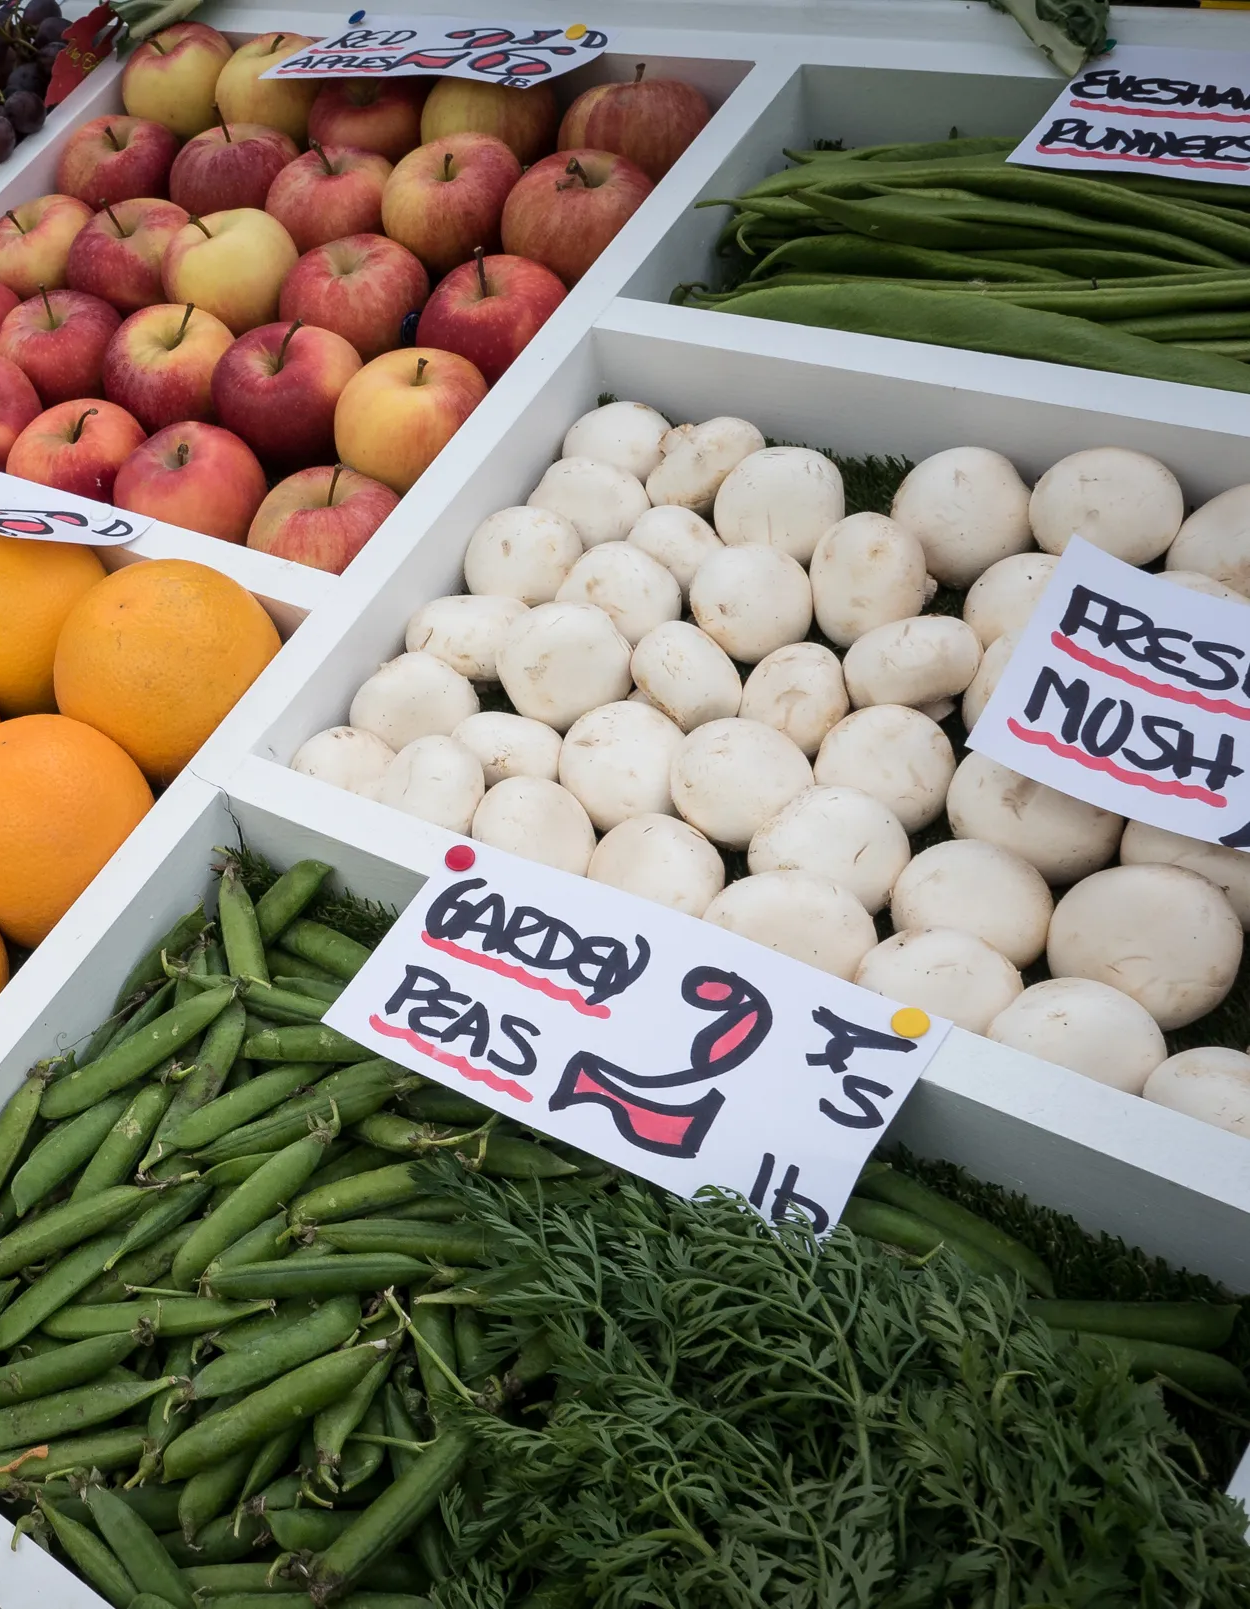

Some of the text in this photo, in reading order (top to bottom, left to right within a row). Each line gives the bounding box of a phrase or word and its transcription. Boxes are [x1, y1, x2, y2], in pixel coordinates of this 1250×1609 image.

[281, 55, 399, 71] APPLES
[324, 30, 418, 49] RED
[92, 519, 134, 537] D
[1023, 666, 1245, 792] MOSH
[425, 878, 651, 1006] GARDEN
[385, 965, 541, 1077] PEAS
